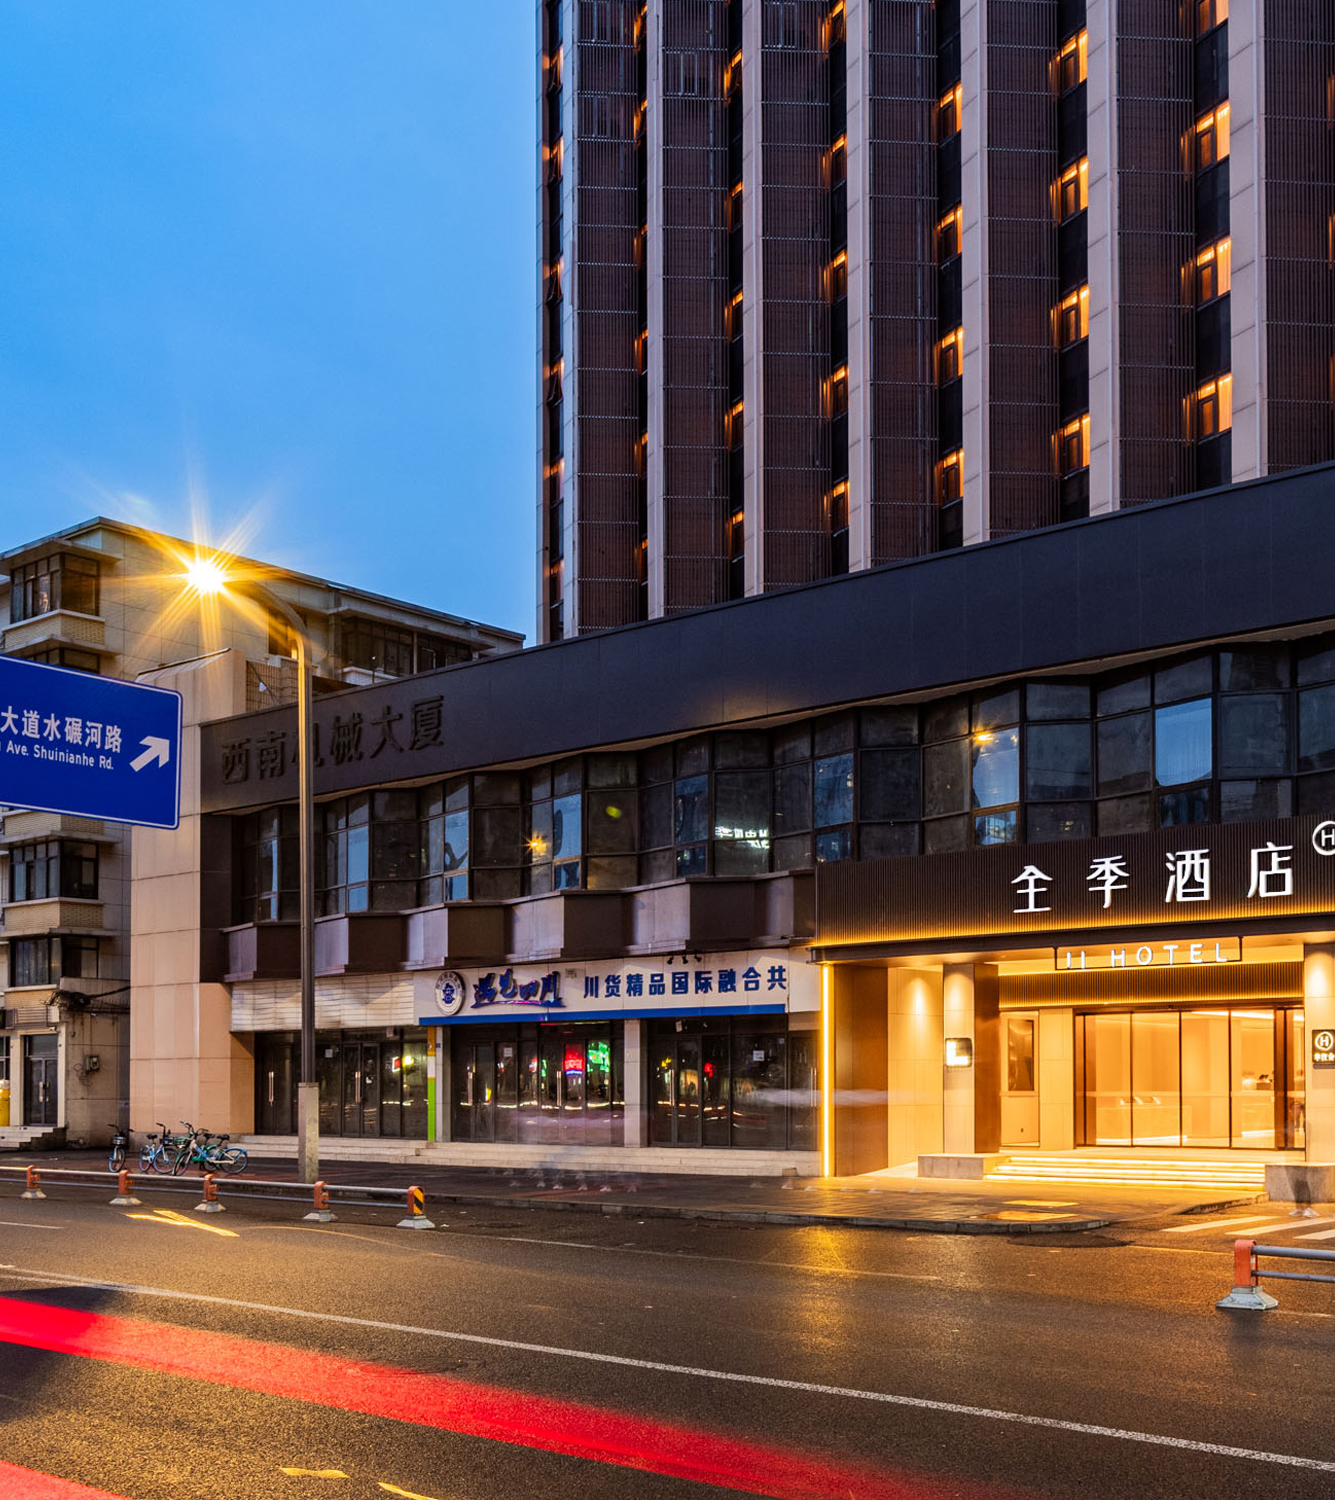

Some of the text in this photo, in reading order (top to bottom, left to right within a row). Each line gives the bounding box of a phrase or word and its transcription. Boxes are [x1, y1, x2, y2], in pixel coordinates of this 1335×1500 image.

[6, 740, 29, 756] Ave.
[33, 745, 94, 767] Shuinianhe
[99, 756, 114, 770] Rd.
[1011, 841, 1294, 913] 全季酒店
[1111, 942, 1228, 968] HOTEL
[584, 965, 787, 999] 川货精品国际融合共
